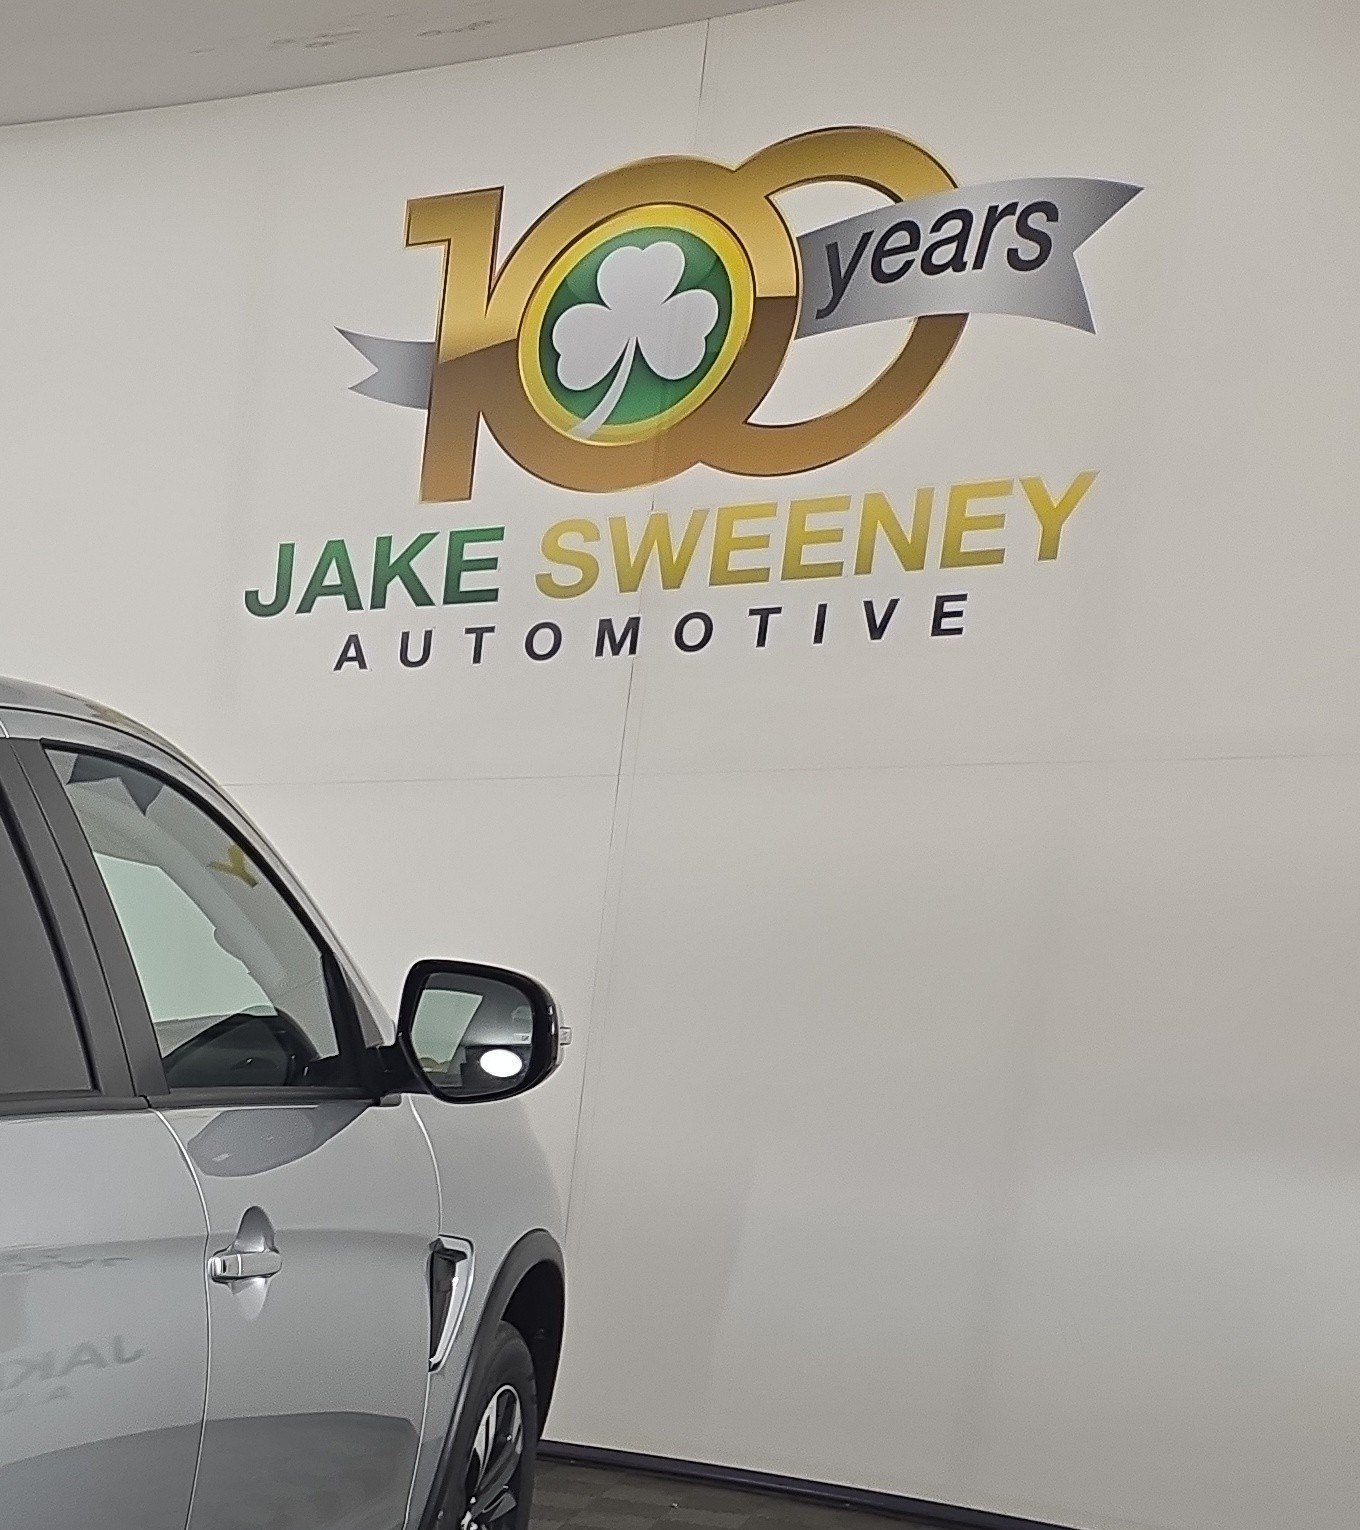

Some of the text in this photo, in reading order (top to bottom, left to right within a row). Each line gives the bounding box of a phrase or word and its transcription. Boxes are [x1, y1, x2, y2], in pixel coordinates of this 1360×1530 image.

[816, 197, 1060, 320] years
[243, 470, 1100, 619] JAKE SWEENEY
[333, 593, 968, 671] AUTOMOTIVE
